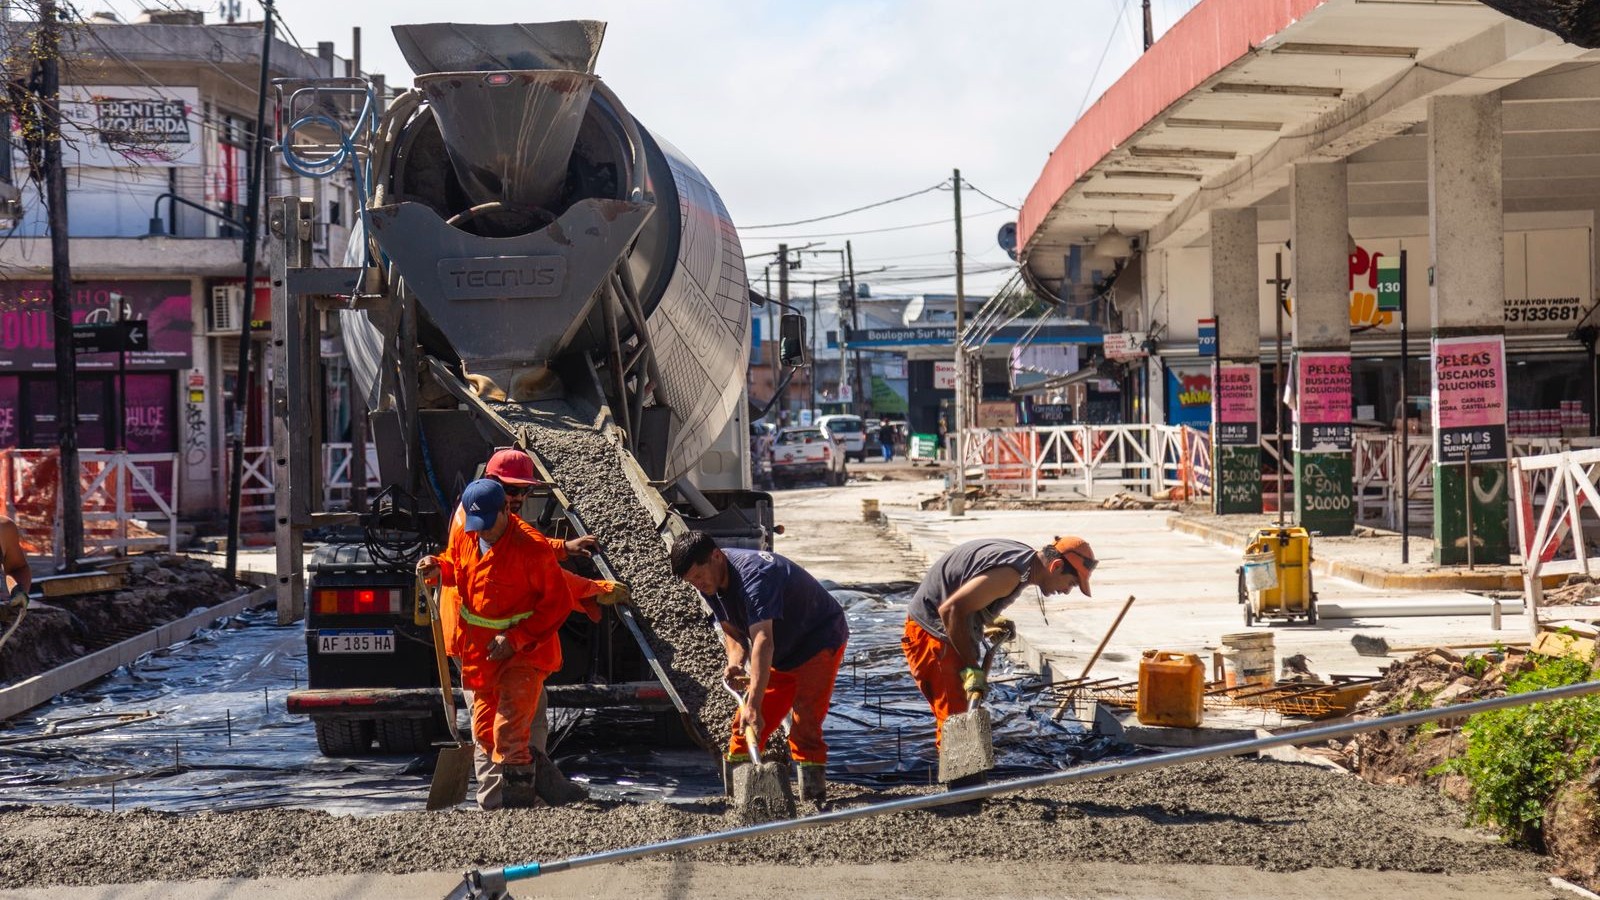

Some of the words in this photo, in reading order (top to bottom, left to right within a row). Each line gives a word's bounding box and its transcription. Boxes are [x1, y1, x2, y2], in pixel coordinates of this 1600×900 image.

[100, 100, 163, 117] FRENTE
[164, 105, 182, 116] DE
[100, 118, 188, 134] IZQUIERDA
[450, 269, 554, 287] TECNUS
[1378, 282, 1400, 292] 130
[868, 330, 915, 342] Boulogne
[916, 329, 934, 339] Sur
[937, 329, 956, 338] Mer
[1437, 352, 1491, 366] PELEAS
[1438, 368, 1495, 380] USCAMOS
[1305, 377, 1351, 385] BUSCAMO
[1437, 380, 1496, 391] OLUCIONES
[322, 637, 339, 651] AF
[344, 636, 369, 651] 185
[374, 636, 392, 650] HA
